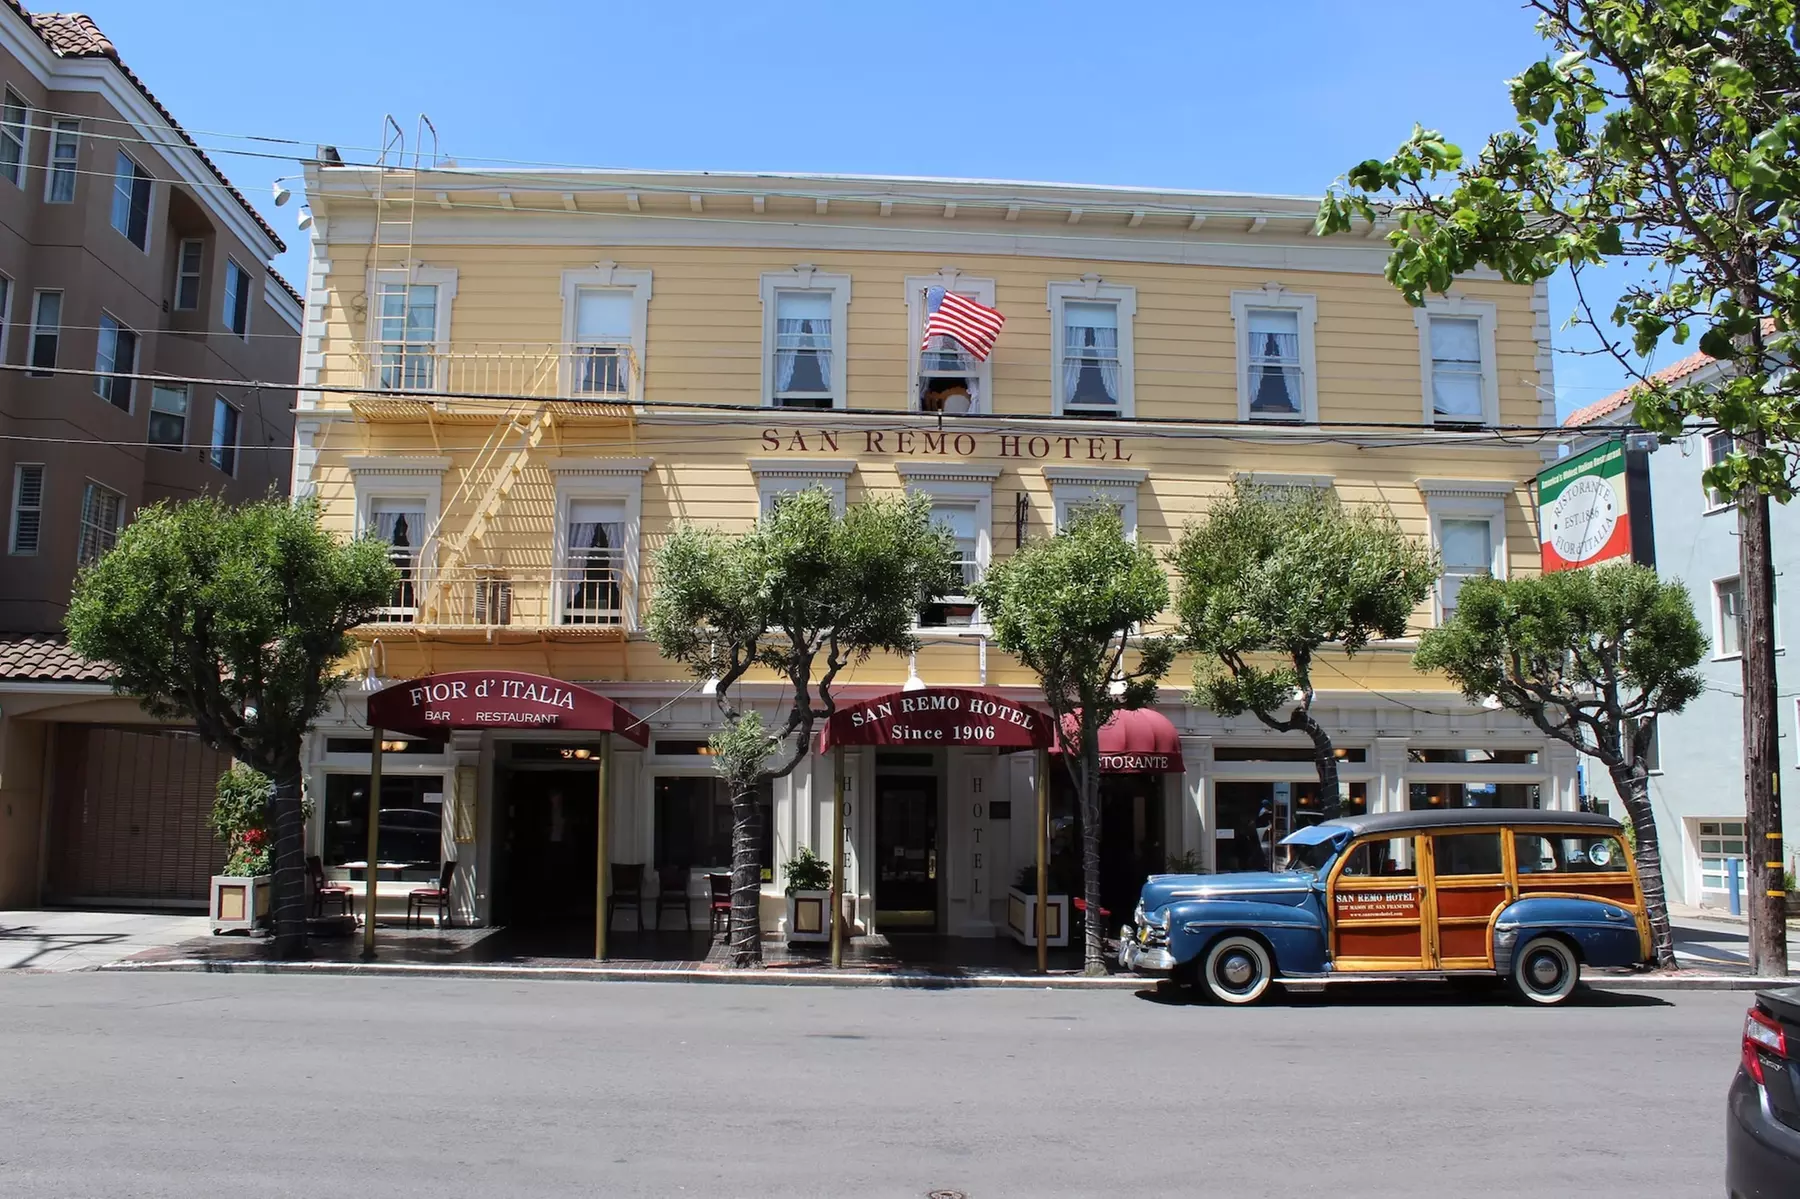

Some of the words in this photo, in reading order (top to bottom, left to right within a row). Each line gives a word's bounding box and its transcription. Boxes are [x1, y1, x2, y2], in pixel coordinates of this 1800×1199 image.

[762, 429, 840, 452] SAN
[864, 430, 976, 456] REMO
[1000, 435, 1133, 462] HOTEL
[1553, 480, 1610, 518] RISTORANTE
[409, 681, 468, 706] FIOR
[501, 680, 574, 710] ITALIA
[425, 711, 450, 721] BAR
[476, 712, 559, 723] RESTAURANT
[852, 702, 893, 727] SAN
[901, 696, 959, 713] REMO
[968, 699, 1034, 730] HOTEL
[891, 725, 943, 740] Since
[953, 726, 995, 740] 1906
[1098, 755, 1168, 769] TORANTE
[843, 777, 852, 893] HOTEL
[972, 777, 983, 894] HOTEL
[1336, 893, 1354, 903] SAN
[1357, 893, 1383, 902] REMO
[1385, 892, 1415, 902] HOTEL
